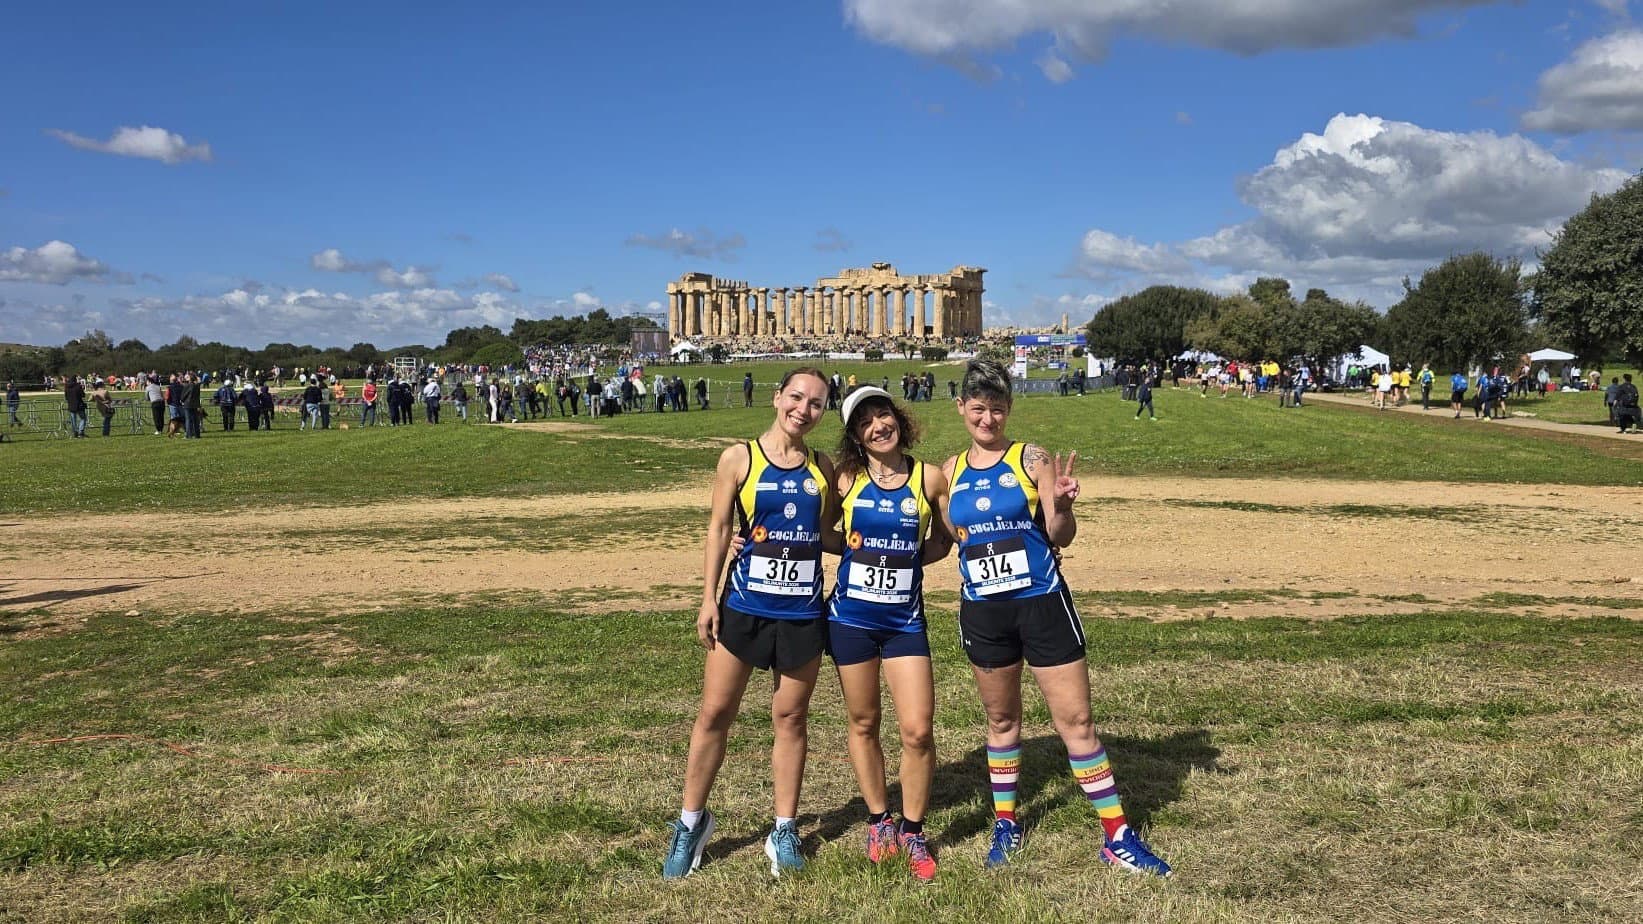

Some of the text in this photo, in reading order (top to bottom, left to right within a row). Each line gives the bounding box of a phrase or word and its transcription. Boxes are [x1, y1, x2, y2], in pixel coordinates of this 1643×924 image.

[768, 525, 820, 542] GUGLIELM
[968, 516, 1032, 534] GUGLIELMO
[863, 533, 919, 551] GUGLIELM
[766, 559, 799, 582] 316
[979, 555, 1013, 579] 314
[864, 566, 898, 589] 315
